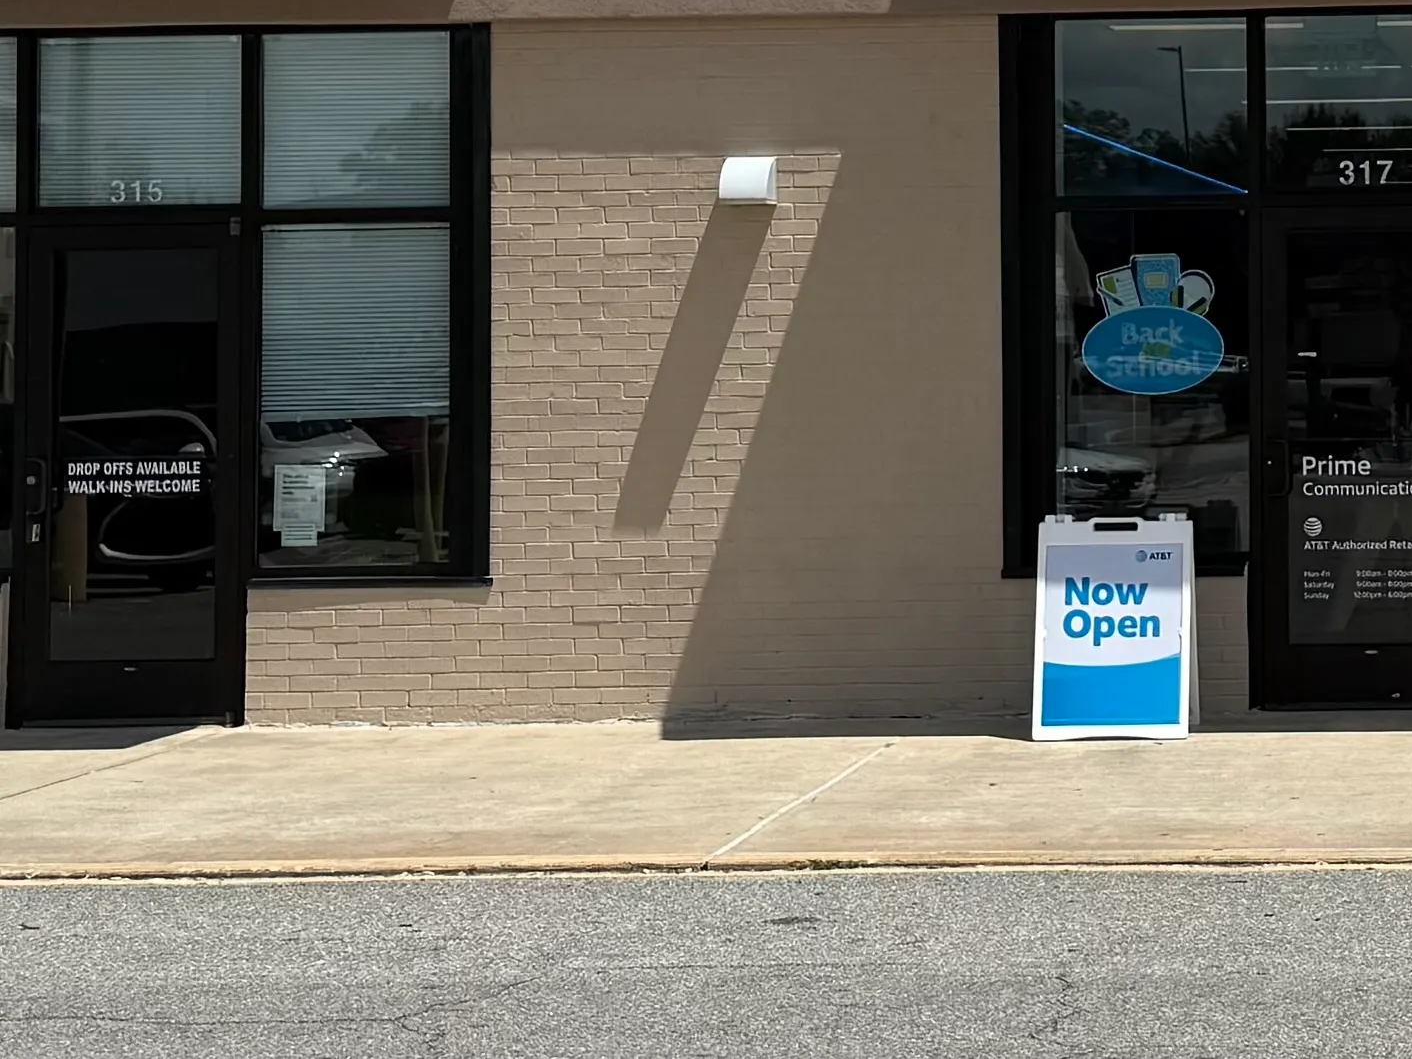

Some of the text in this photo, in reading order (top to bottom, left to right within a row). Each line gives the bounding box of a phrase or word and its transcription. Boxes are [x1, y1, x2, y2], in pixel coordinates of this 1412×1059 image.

[1339, 159, 1394, 186] 317
[110, 180, 163, 203] 315
[1121, 319, 1184, 344] Back
[1106, 350, 1201, 378] School
[67, 460, 201, 476] DROP OFFS AVAILABLE
[1302, 454, 1372, 476] Prime
[134, 478, 201, 493] WELCOME
[1149, 551, 1172, 561] AT&T
[1303, 540, 1329, 551] AT&T
[1331, 539, 1387, 550] Authorized
[1064, 576, 1149, 606] Now
[1062, 609, 1161, 647] Open
